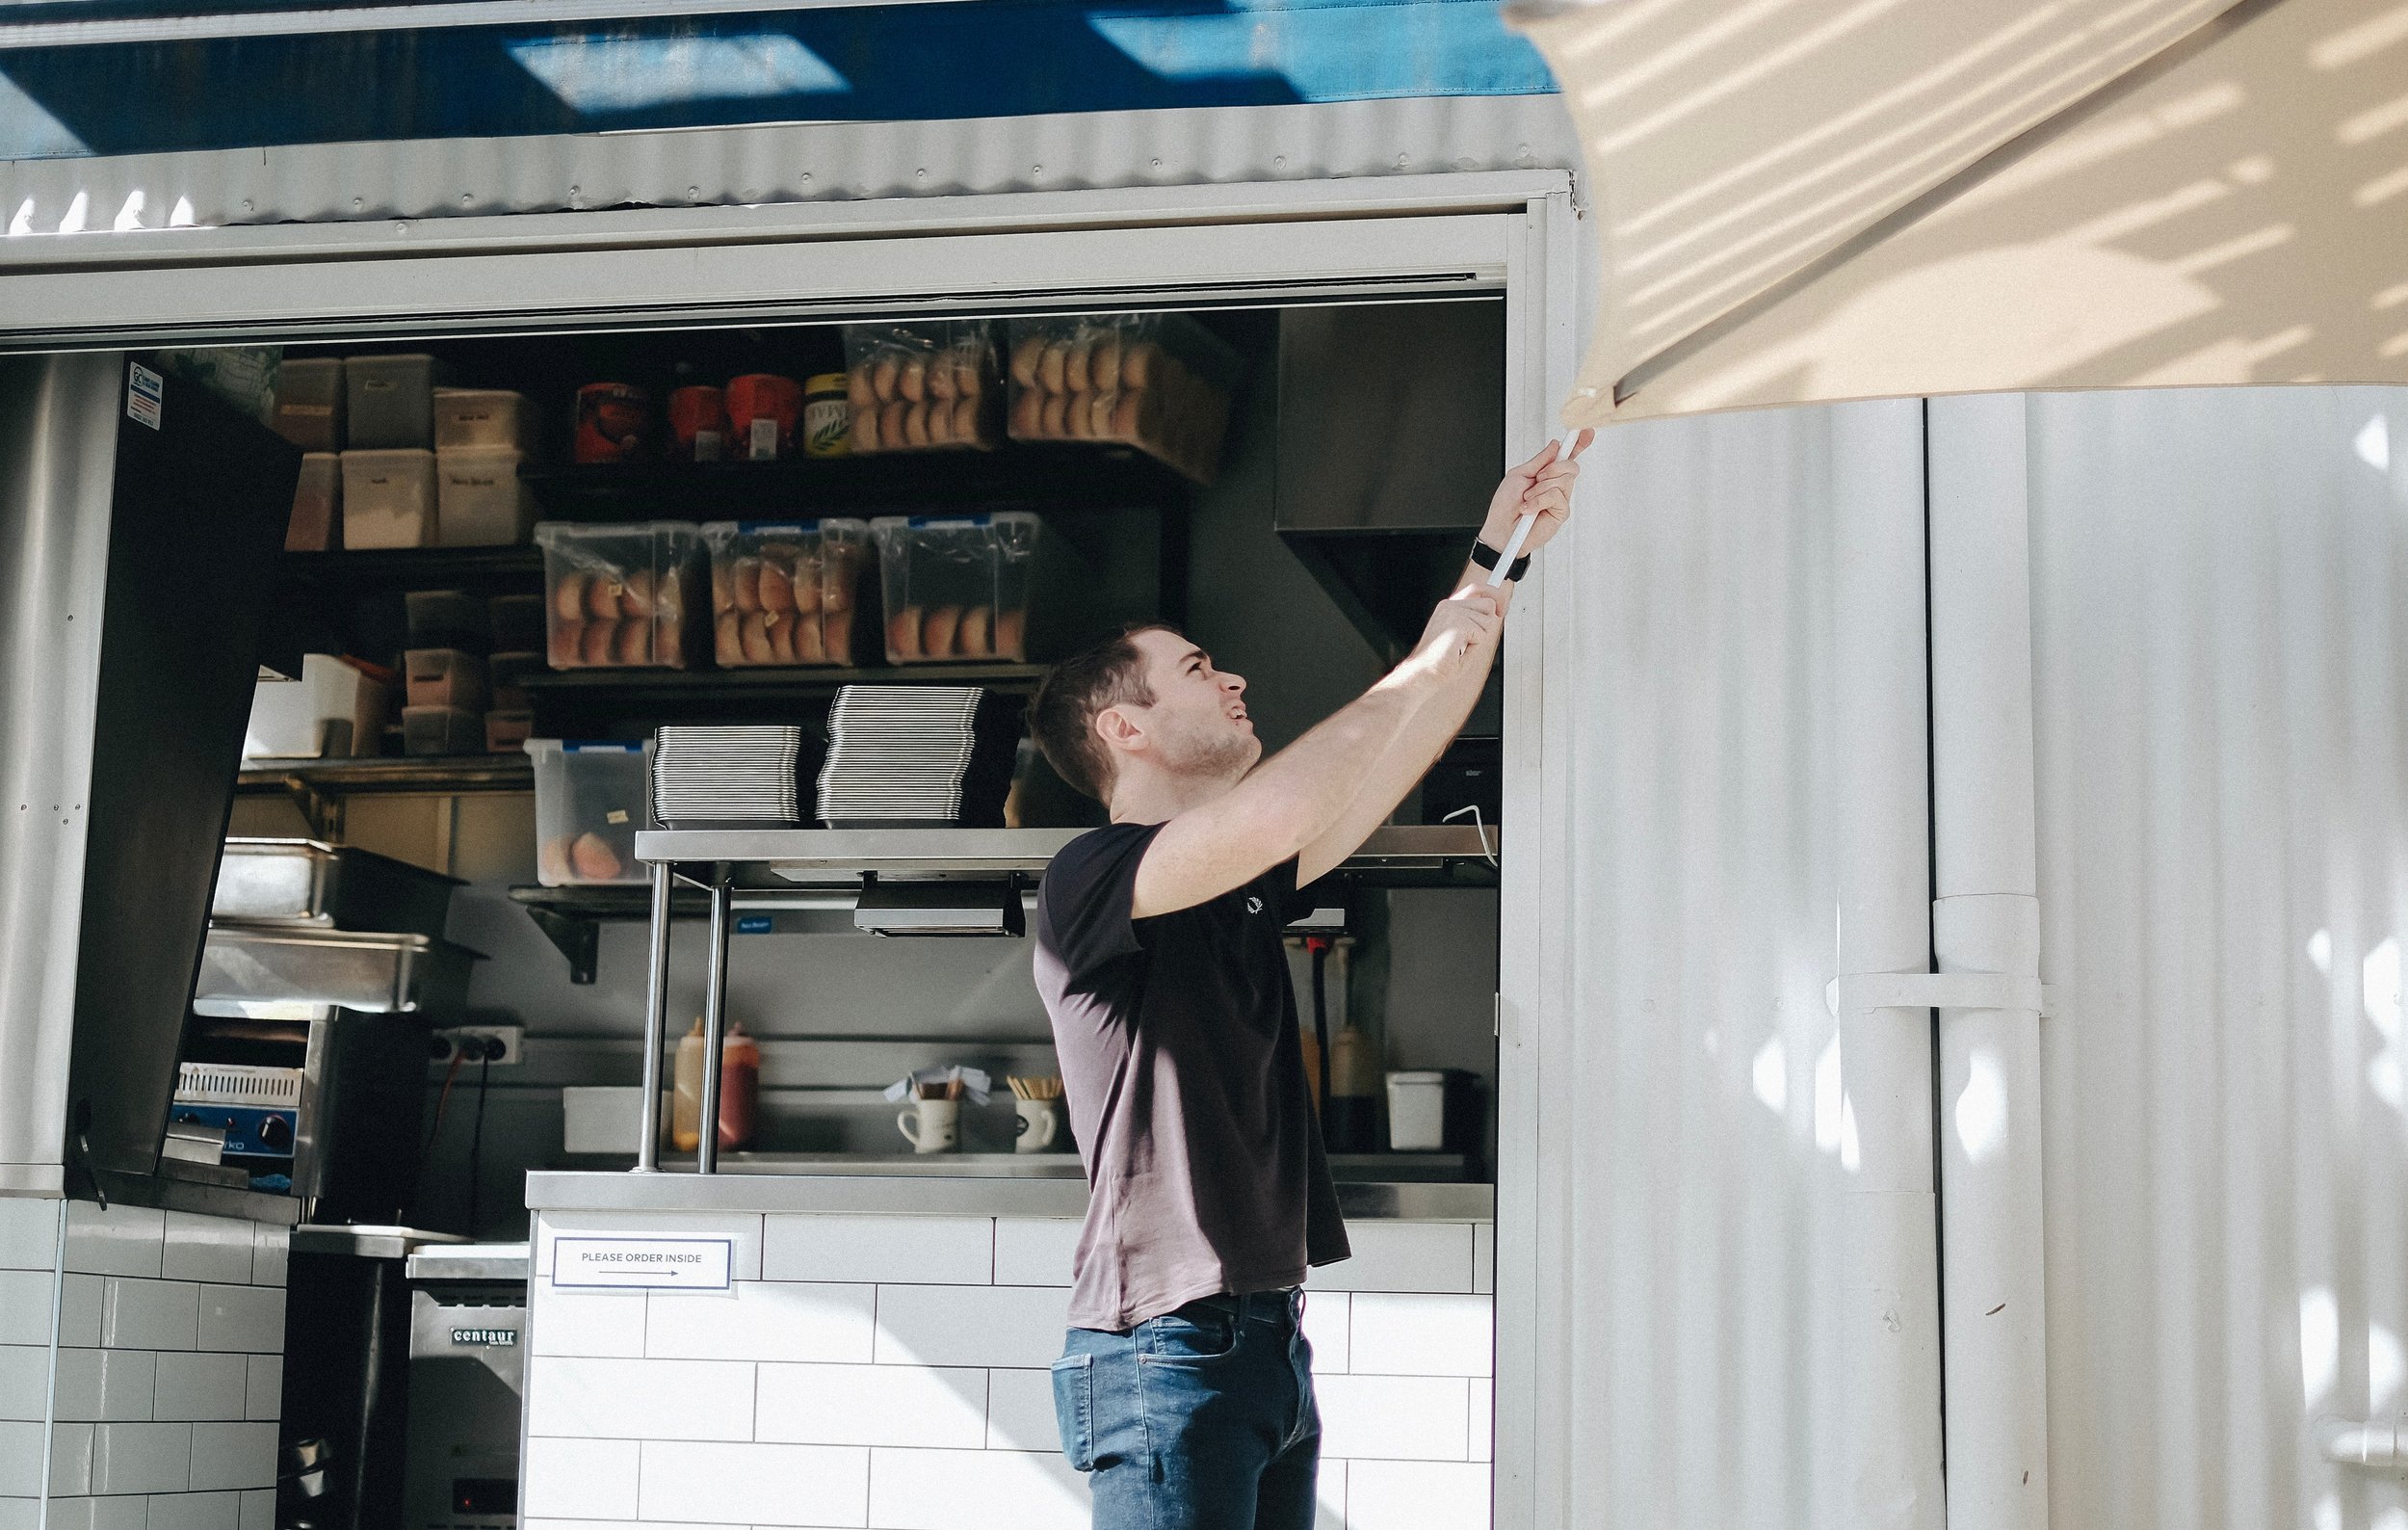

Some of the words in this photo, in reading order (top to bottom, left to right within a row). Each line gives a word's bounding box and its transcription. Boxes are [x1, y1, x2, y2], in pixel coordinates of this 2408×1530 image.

[582, 1253, 623, 1262] PLEASE
[626, 1253, 663, 1263] ORDER
[666, 1254, 702, 1263] INSIDE
[454, 1330, 514, 1342] centaur
